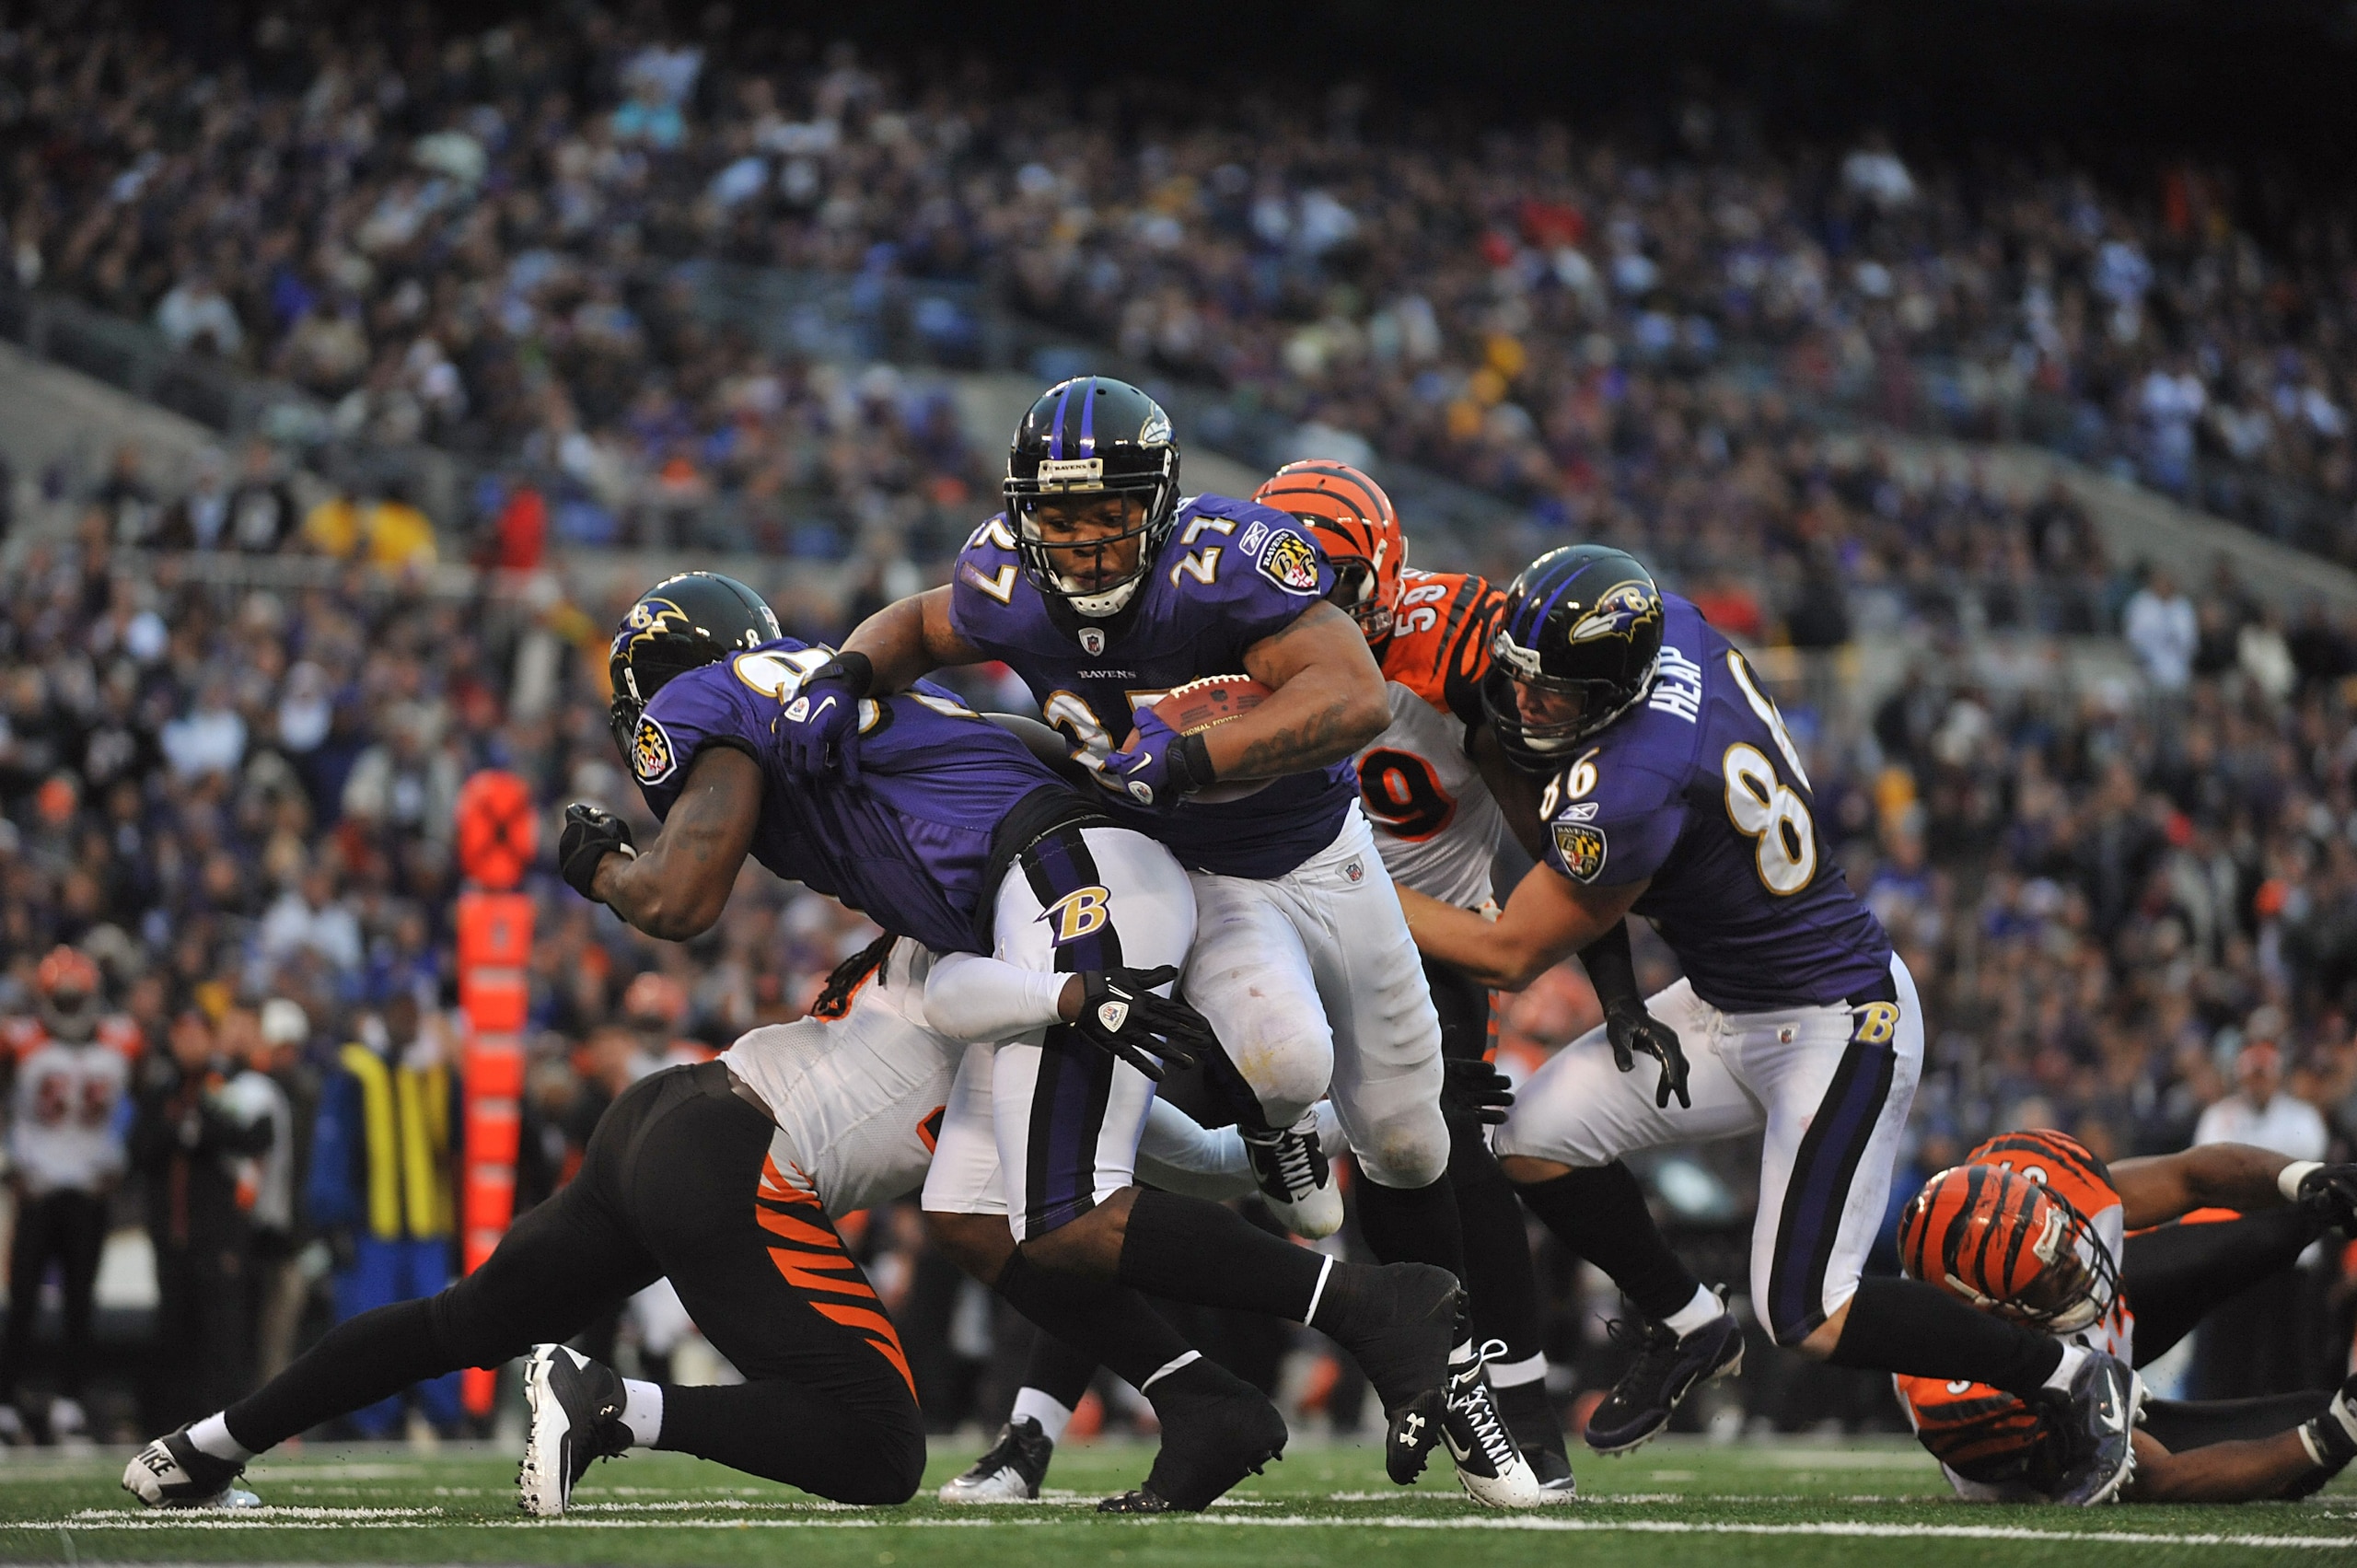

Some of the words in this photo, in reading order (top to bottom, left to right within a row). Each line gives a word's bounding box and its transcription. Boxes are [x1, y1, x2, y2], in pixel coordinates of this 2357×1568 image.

[1169, 516, 1237, 589] 27
[1262, 531, 1290, 567] RAVENS
[1394, 584, 1447, 637] 59
[1076, 670, 1137, 679] RAVENS
[1649, 645, 1702, 725] HEAP
[1180, 723, 1211, 738] TIONAL
[1557, 826, 1597, 840] RAVENS
[1034, 885, 1110, 944] B
[1845, 1000, 1900, 1044] B
